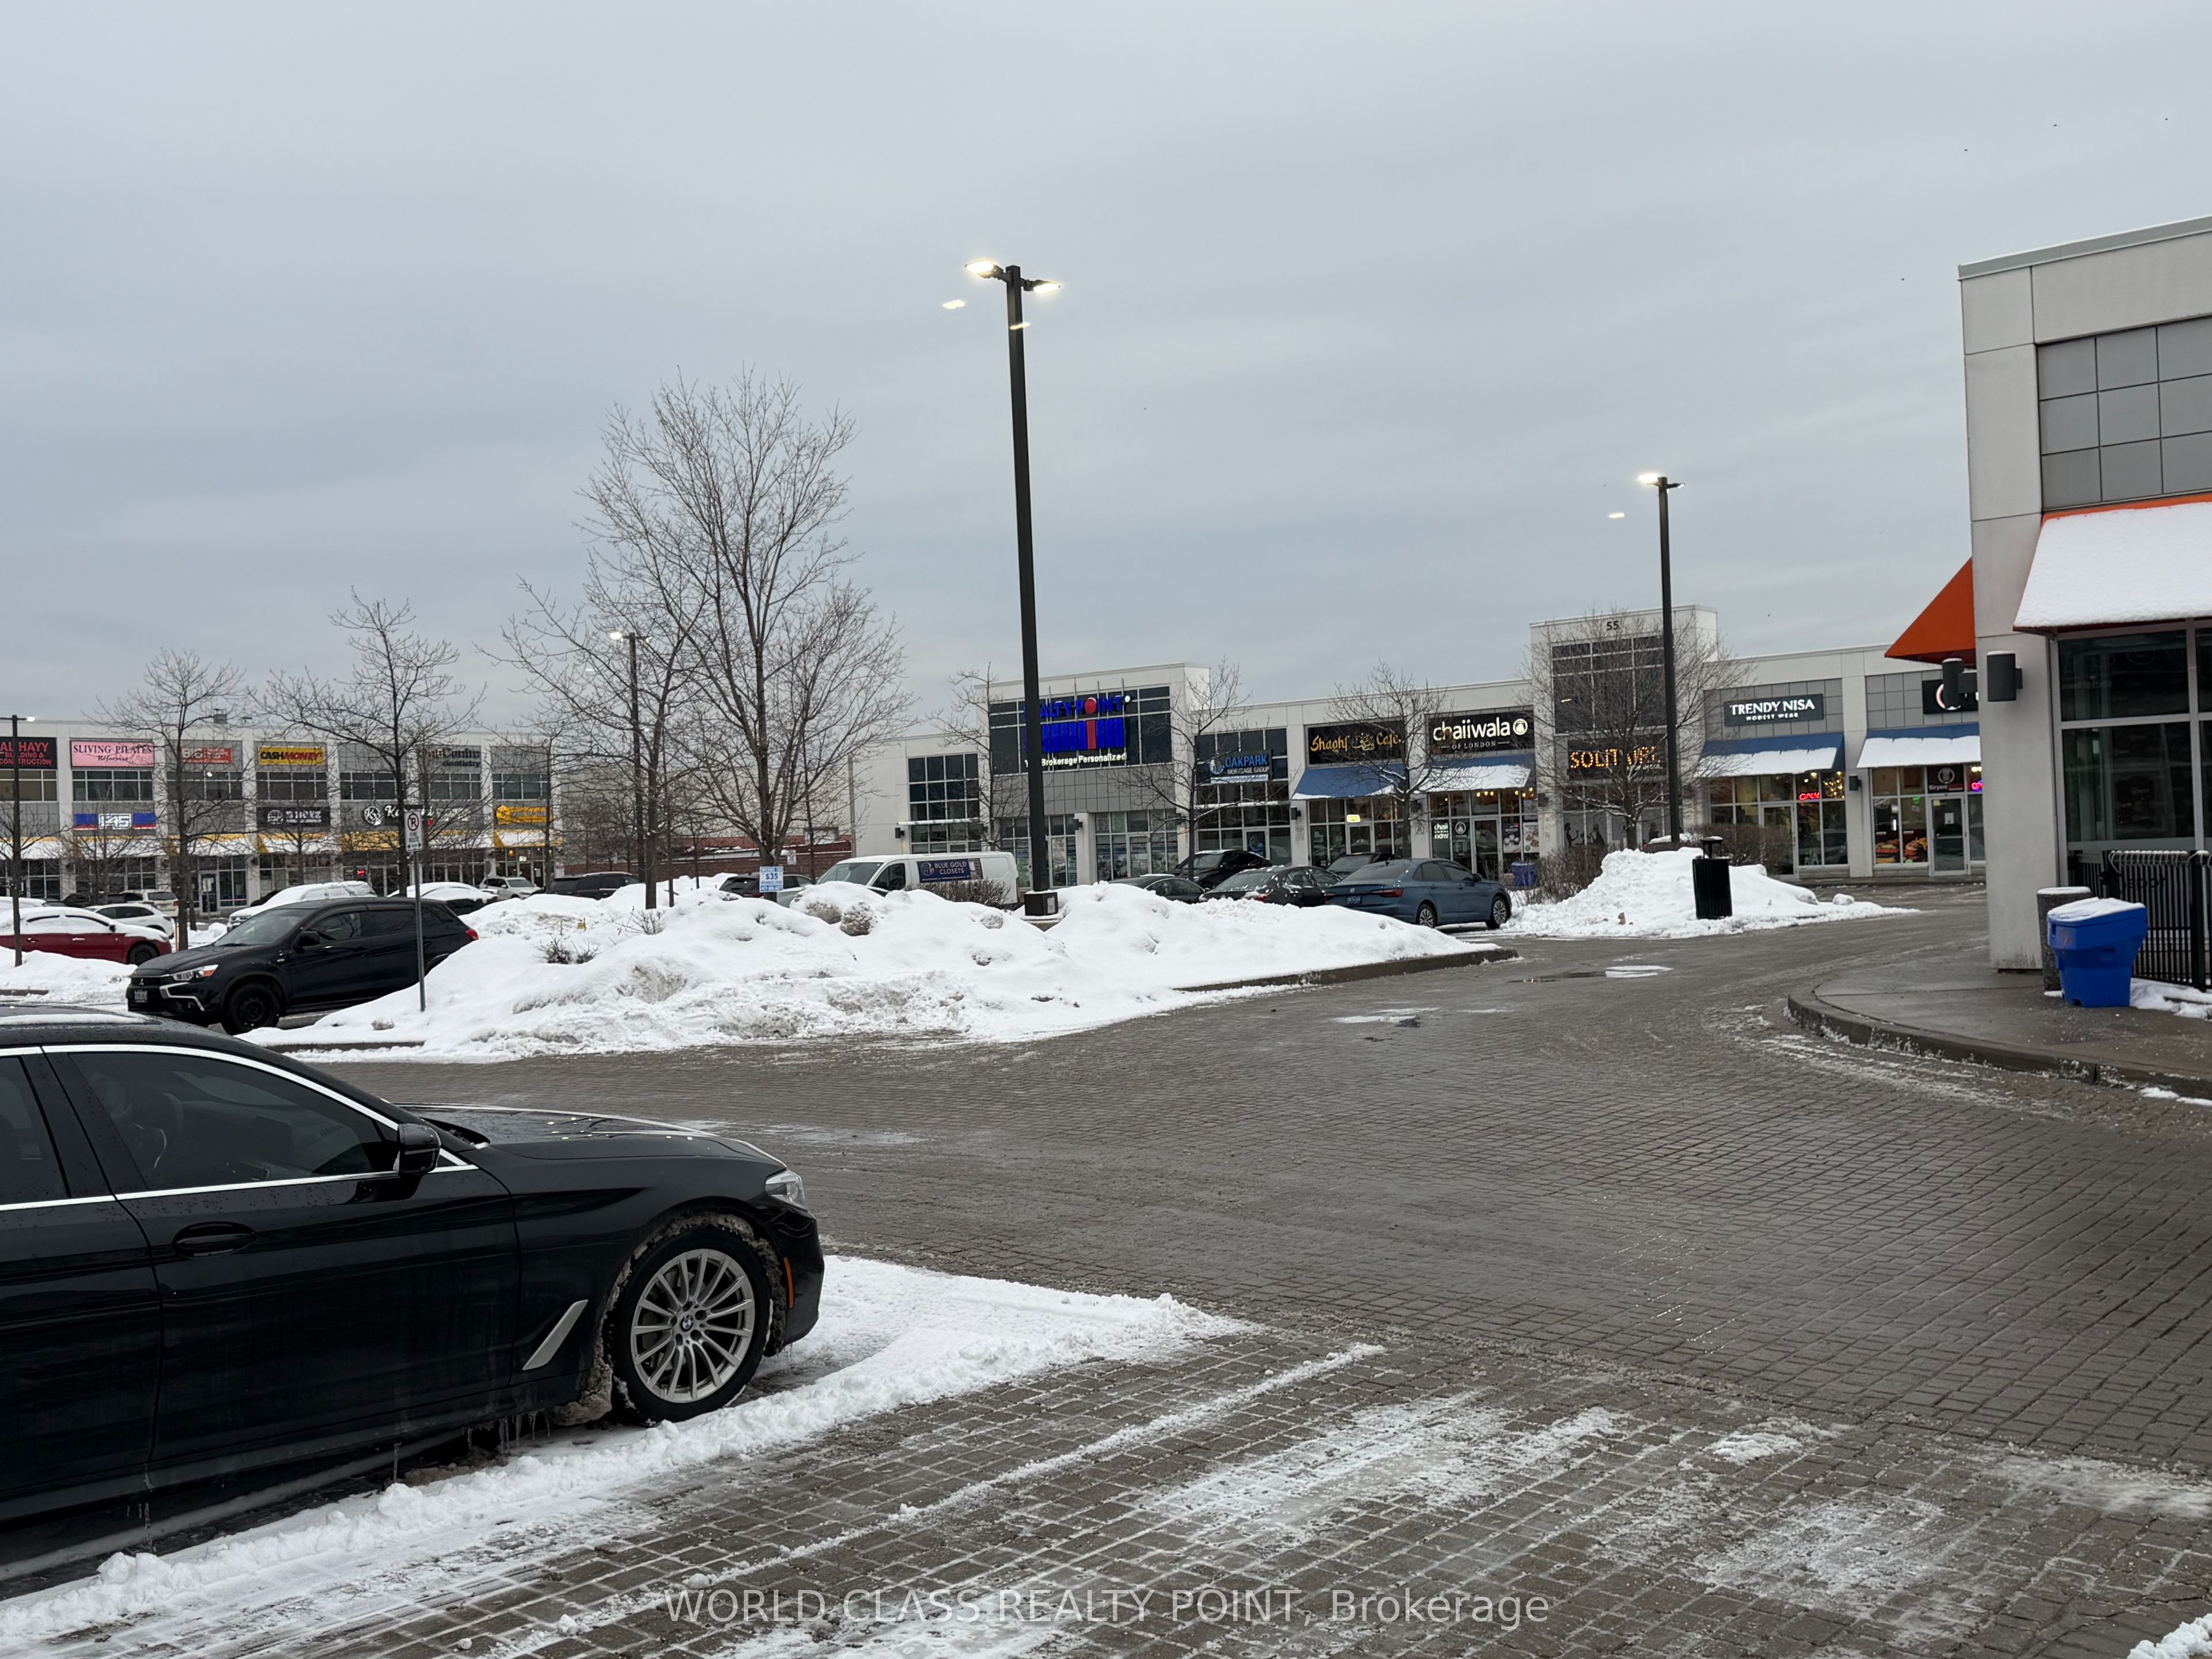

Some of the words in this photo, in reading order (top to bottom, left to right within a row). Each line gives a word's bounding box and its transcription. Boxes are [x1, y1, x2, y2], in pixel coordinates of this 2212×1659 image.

[1607, 620, 1619, 631] 55
[1729, 701, 1781, 715] TRENDY
[1783, 699, 1815, 711] NISA
[1433, 716, 1511, 741] chaiiwala
[73, 744, 111, 753] SLIVING
[1464, 740, 1497, 749] LONDON
[1041, 756, 1078, 767] Brokerage
[1078, 752, 1127, 764] Personalized
[1225, 755, 1267, 768] OAKPARK
